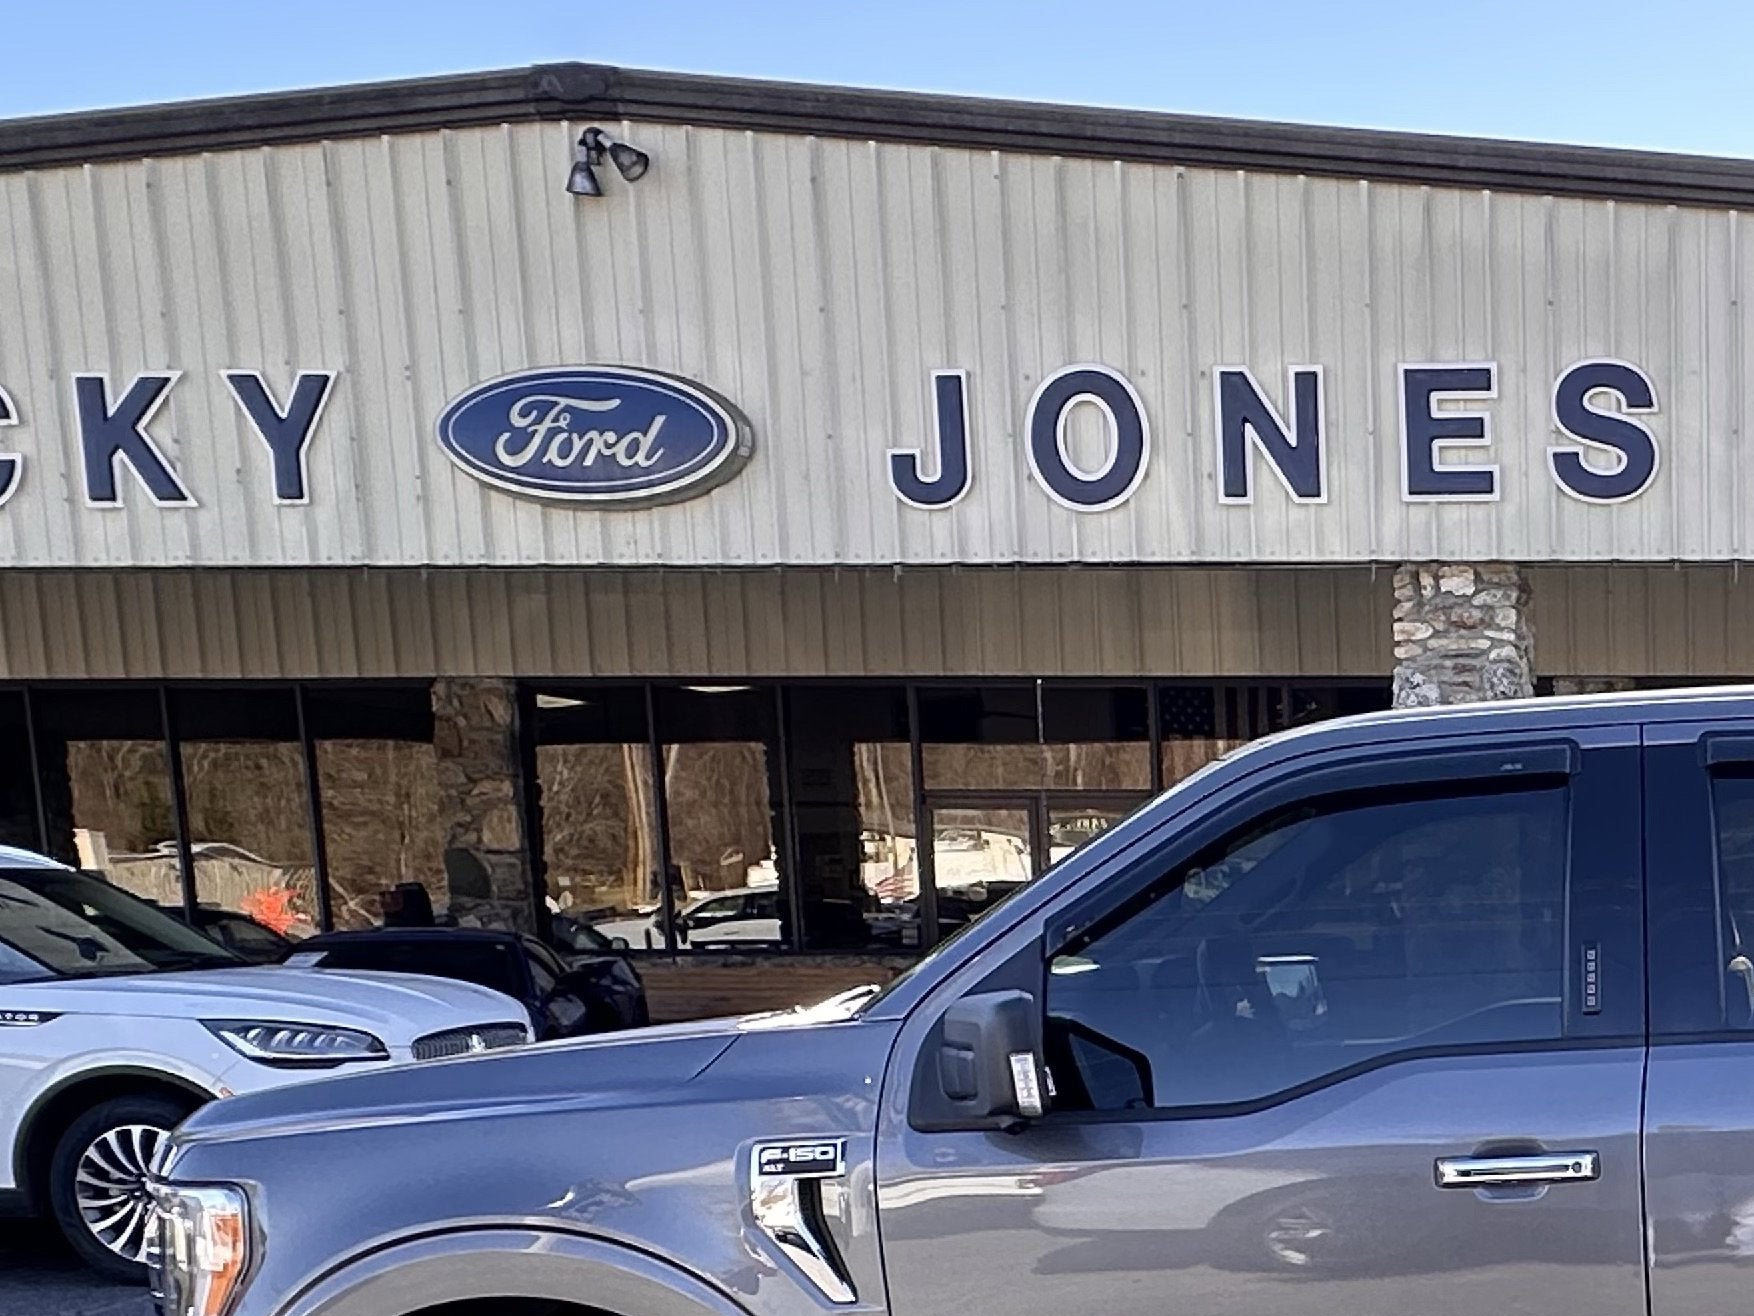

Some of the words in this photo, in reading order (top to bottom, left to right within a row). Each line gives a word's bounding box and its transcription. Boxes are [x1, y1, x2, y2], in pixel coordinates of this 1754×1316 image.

[0, 369, 339, 509] KY
[886, 357, 1661, 512] JONES
[494, 394, 666, 469] Ford
[760, 1145, 836, 1164] F-150
